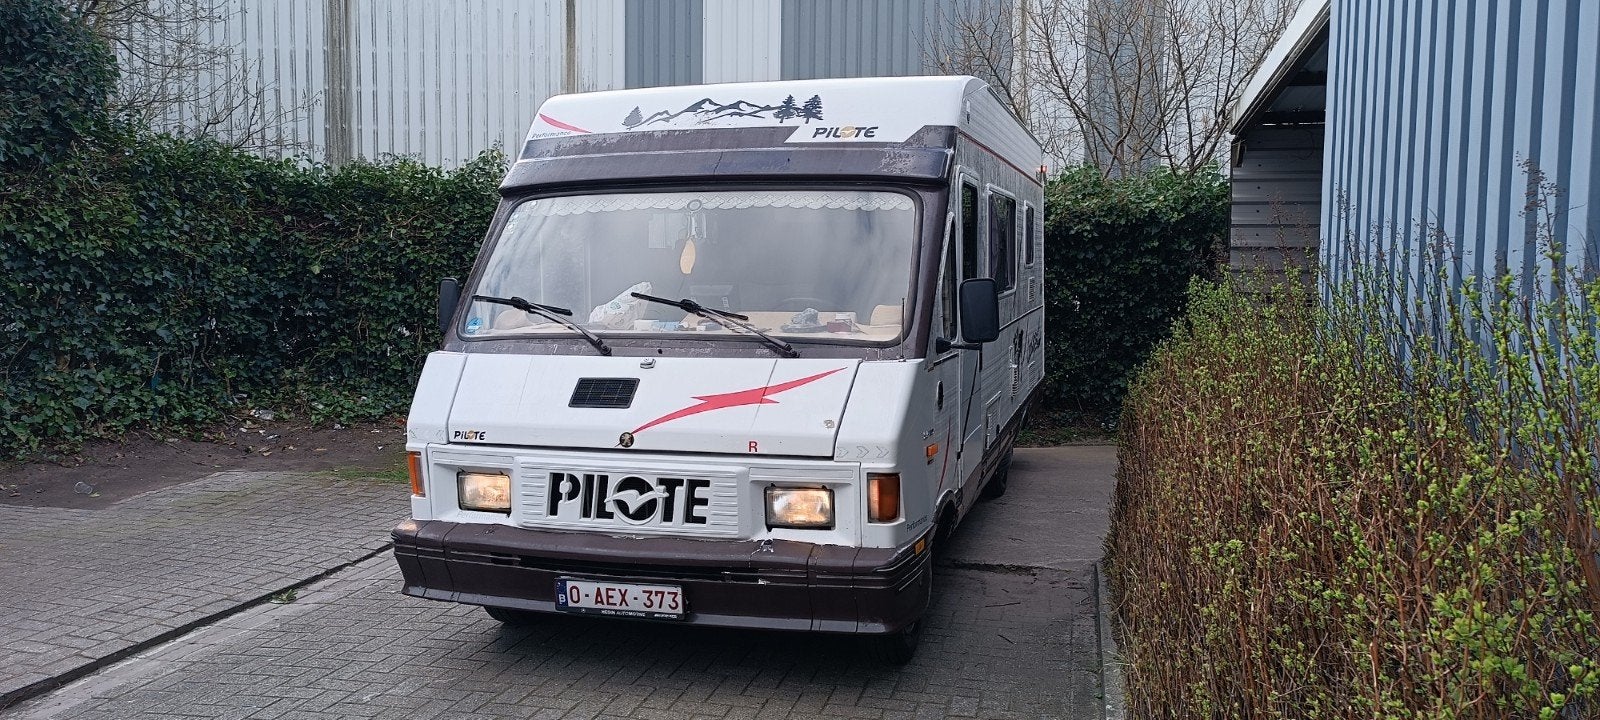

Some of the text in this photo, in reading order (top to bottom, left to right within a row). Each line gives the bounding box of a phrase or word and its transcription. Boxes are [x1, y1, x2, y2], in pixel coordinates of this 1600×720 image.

[748, 440, 758, 453] R
[547, 472, 711, 525] PILOTE
[559, 594, 566, 605] B
